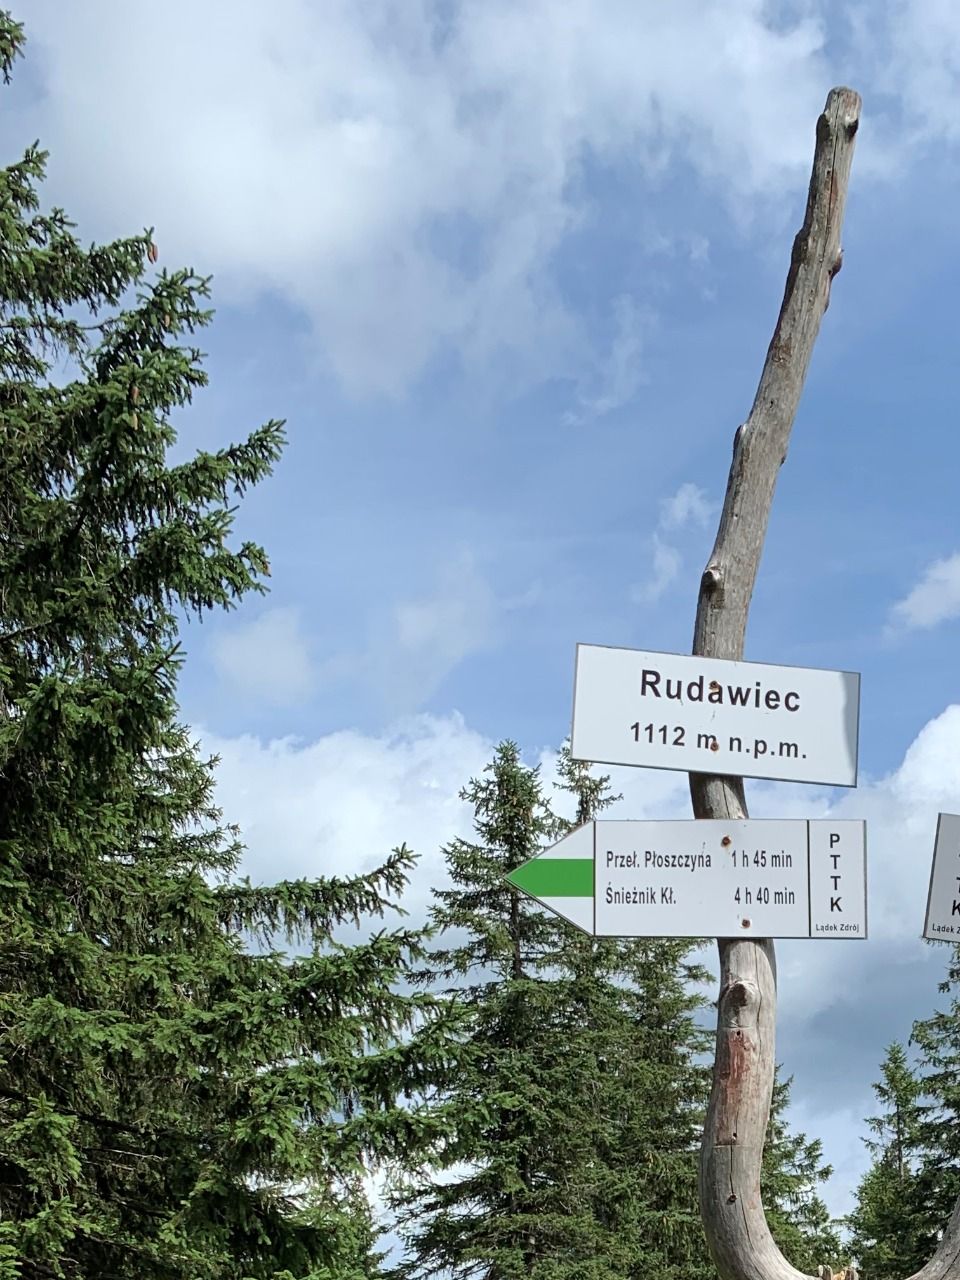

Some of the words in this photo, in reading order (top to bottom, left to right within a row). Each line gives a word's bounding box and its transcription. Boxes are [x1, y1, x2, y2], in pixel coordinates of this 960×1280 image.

[640, 669, 801, 712] Rudawiec
[630, 722, 686, 747] 1112
[697, 733, 719, 752] m
[729, 735, 808, 760] n.p.m.
[606, 850, 640, 869] Przeł.
[731, 850, 737, 868] 1
[742, 850, 749, 868] h
[753, 850, 767, 868] 45
[771, 850, 792, 868] min
[605, 881, 657, 905] Śnieżnik
[660, 887, 677, 905] Kł.
[734, 887, 741, 905] 4
[745, 887, 752, 905] h
[756, 887, 770, 905] 40
[774, 887, 795, 905] min
[815, 924, 838, 933] Lądek
[840, 923, 860, 933] Zdrój
[932, 923, 955, 934] Lądek
